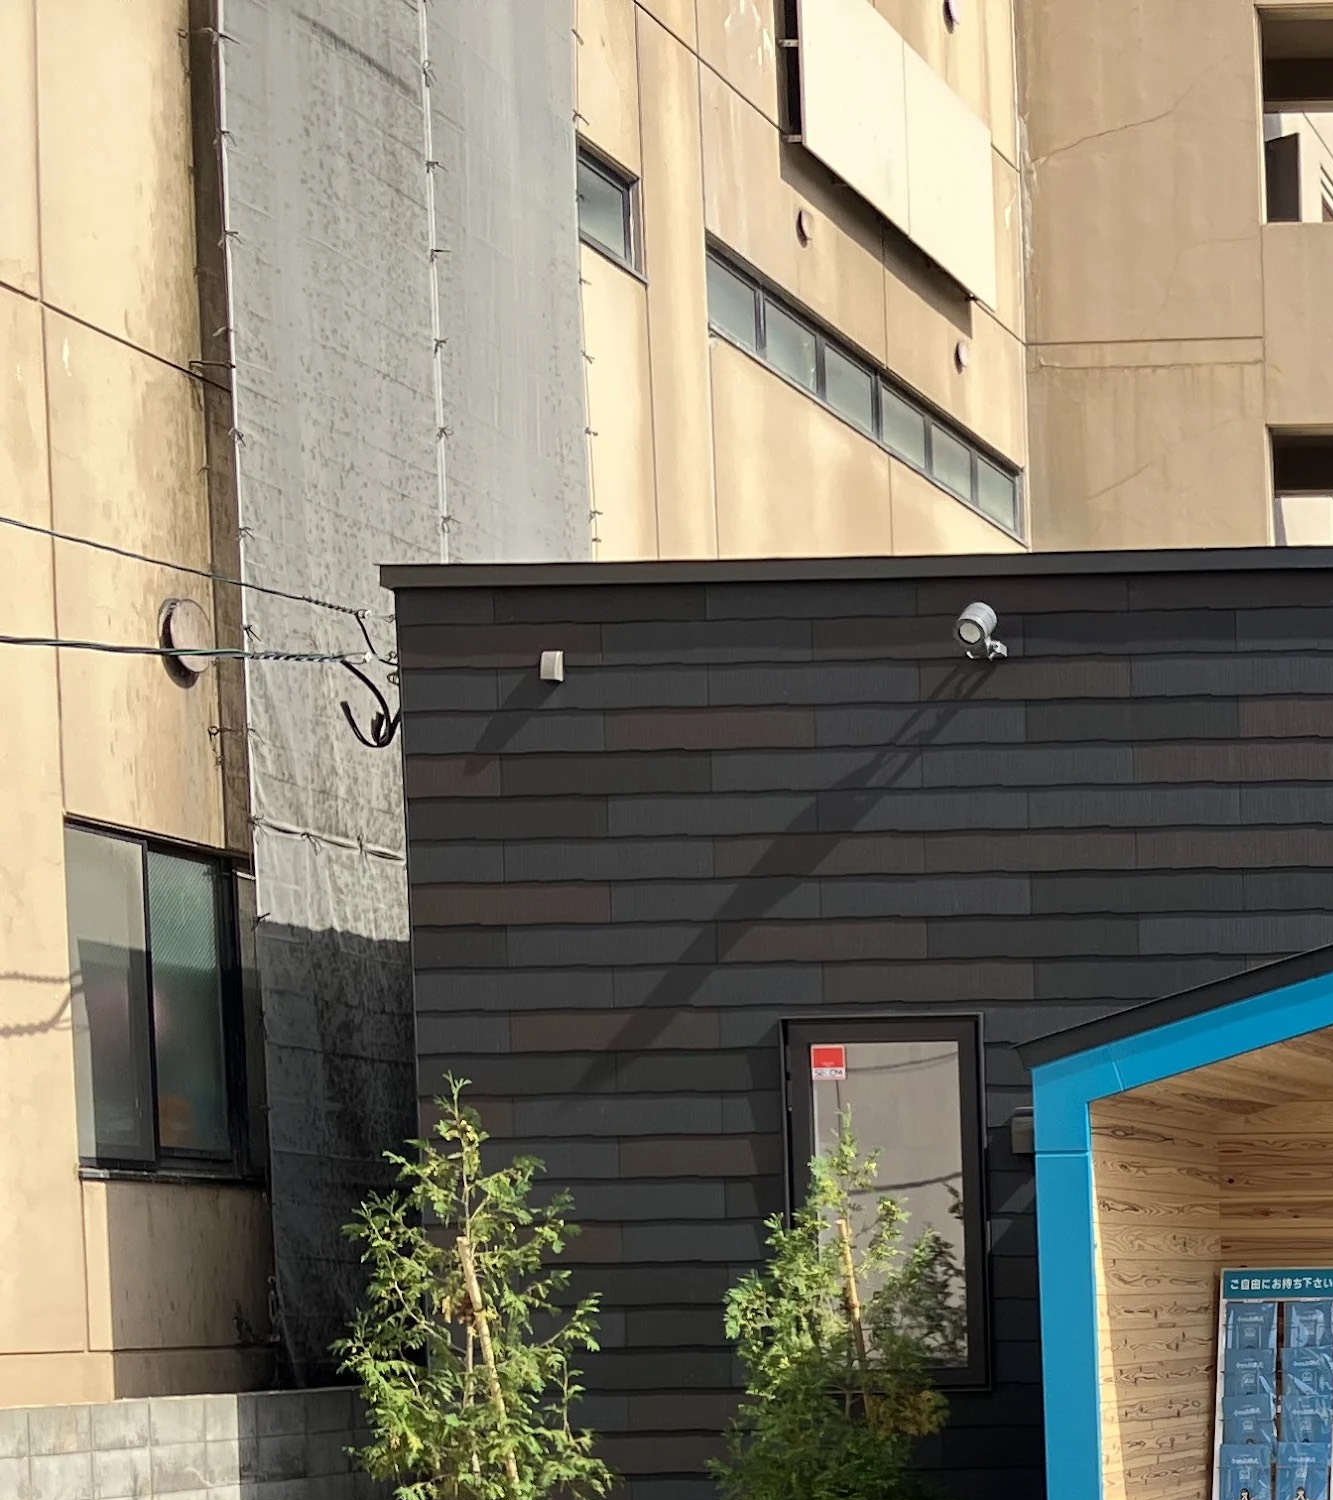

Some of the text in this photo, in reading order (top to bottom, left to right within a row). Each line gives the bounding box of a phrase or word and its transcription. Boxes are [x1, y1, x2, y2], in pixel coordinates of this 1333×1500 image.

[1230, 1277, 1333, 1291] ご自由にお持ち下さい
